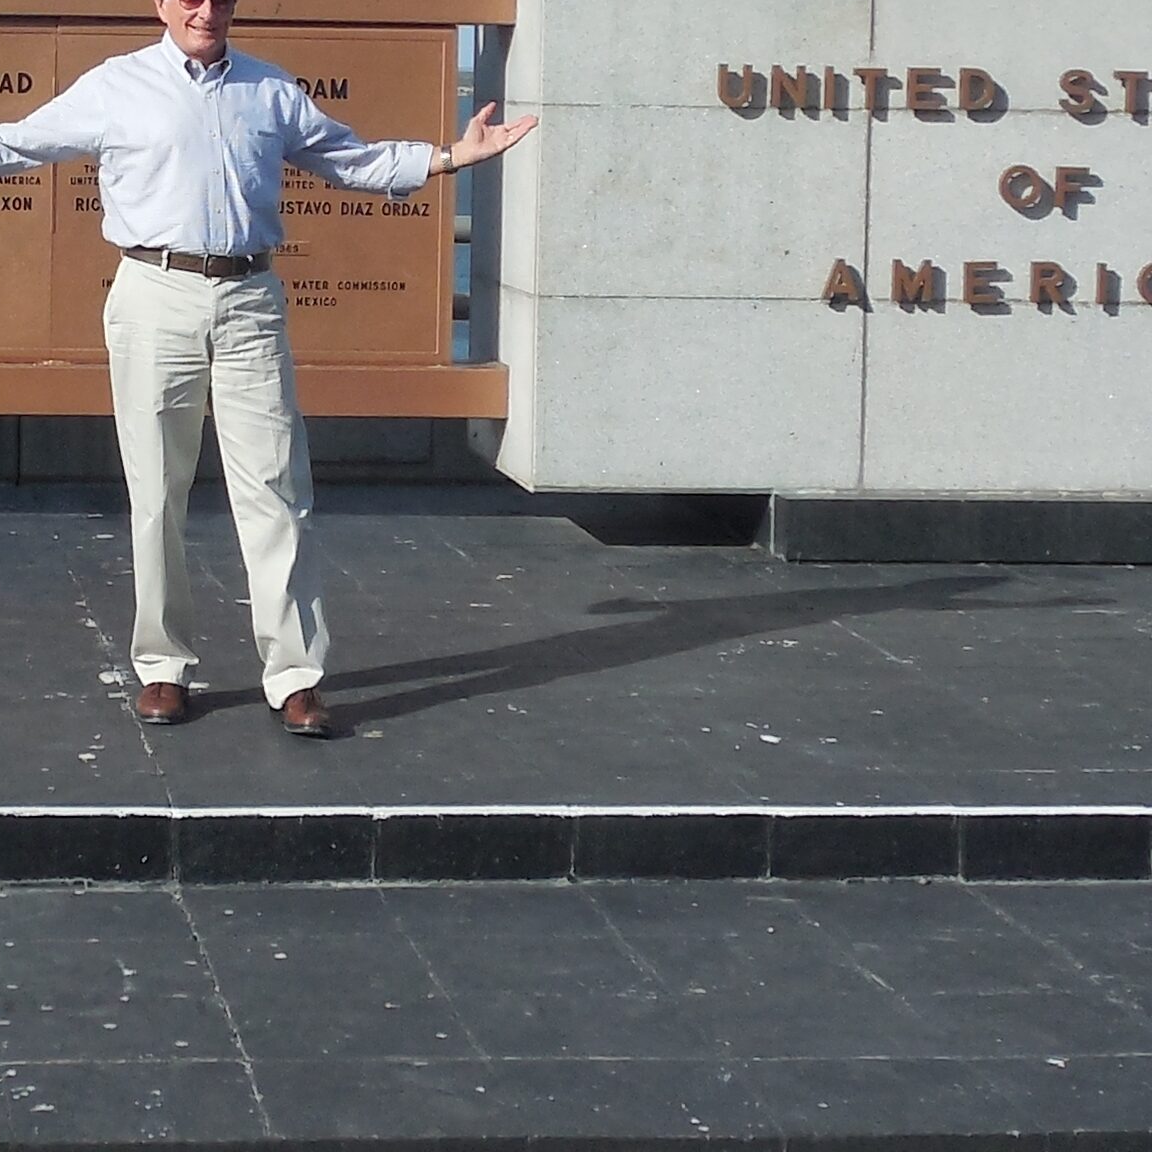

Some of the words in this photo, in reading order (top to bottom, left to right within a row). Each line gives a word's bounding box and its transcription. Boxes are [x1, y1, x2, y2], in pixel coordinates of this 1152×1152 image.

[717, 63, 997, 111] UNITED
[70, 177, 99, 186] UNITE
[281, 180, 315, 190] NITED
[998, 165, 1091, 209] OF
[279, 201, 332, 215] USTAVO
[340, 202, 374, 216] DIAZ
[381, 203, 431, 217] ORDAZ
[292, 280, 329, 290] WATER
[337, 281, 406, 291] COMMISSION
[296, 297, 337, 307] MEXICO
